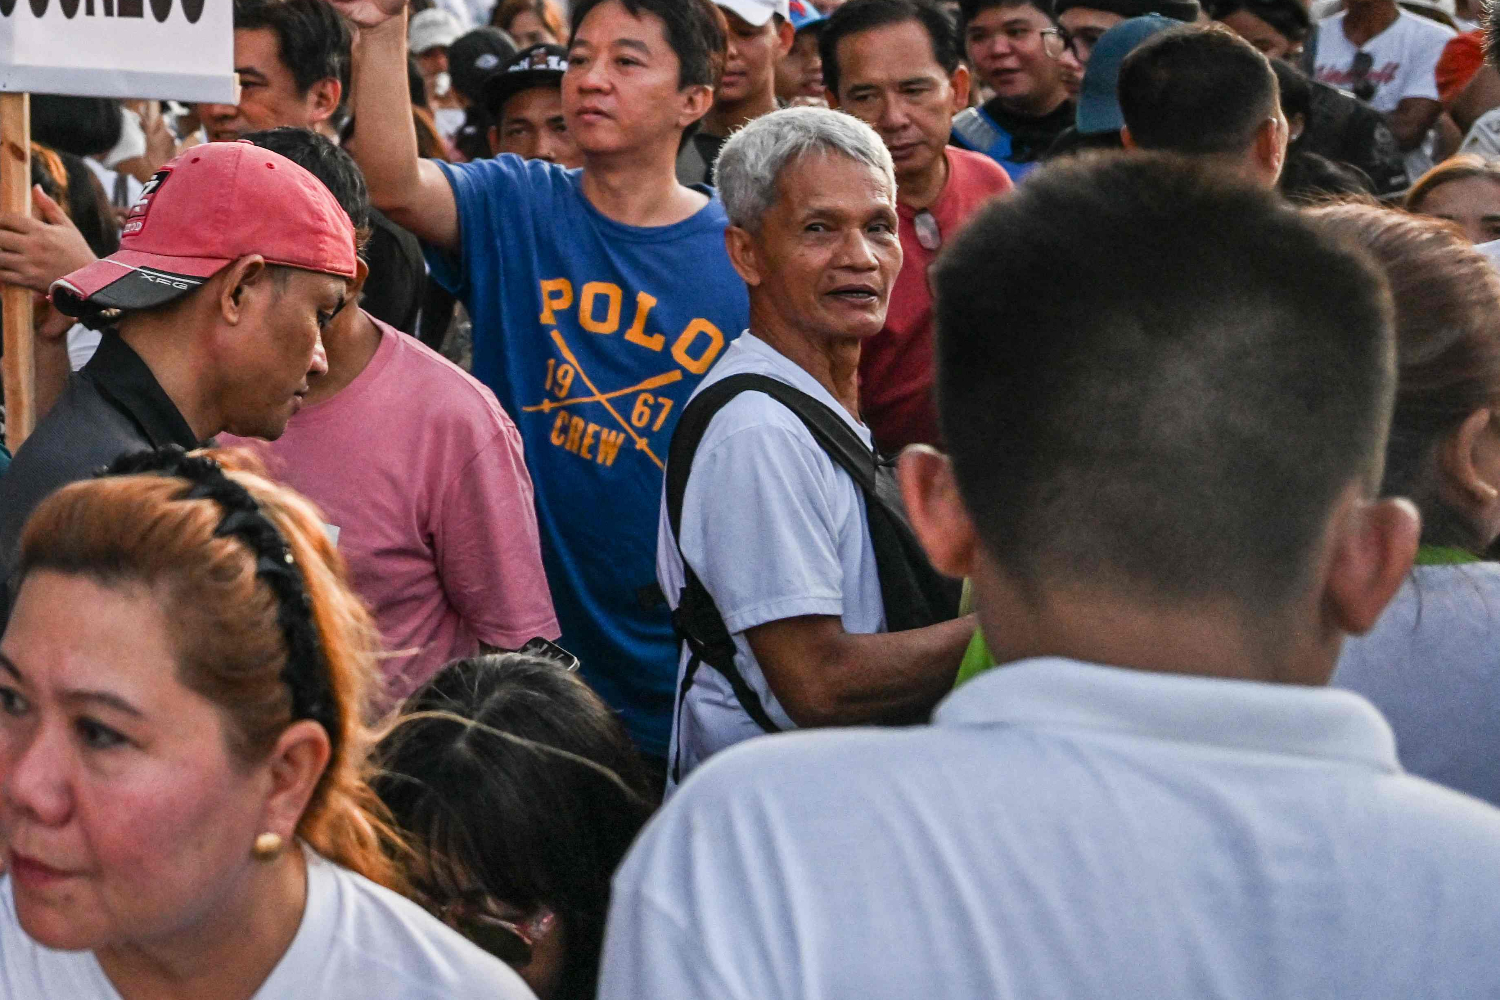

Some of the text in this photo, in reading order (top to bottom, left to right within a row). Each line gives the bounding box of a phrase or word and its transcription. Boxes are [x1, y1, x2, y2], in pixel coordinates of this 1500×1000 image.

[539, 278, 725, 375] POLO
[544, 358, 674, 432] 19 67
[551, 410, 626, 467] CREW
